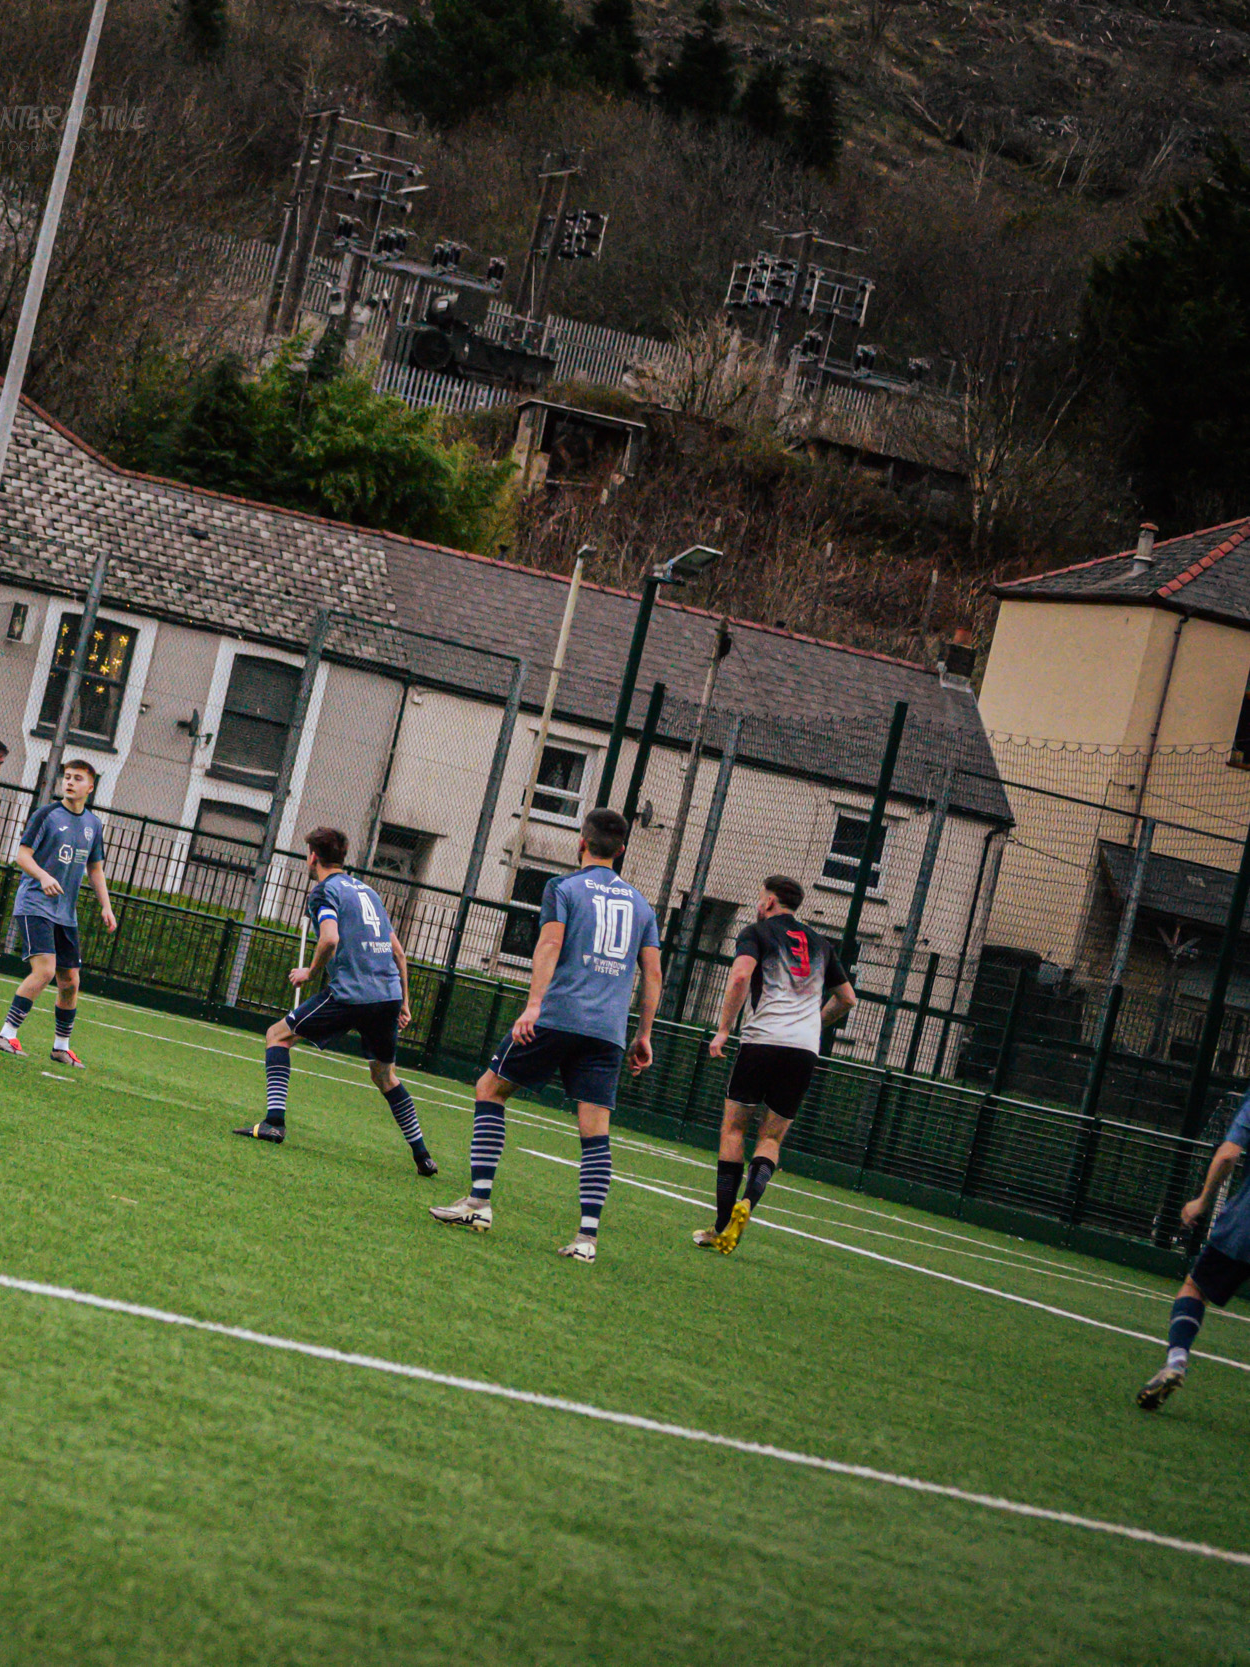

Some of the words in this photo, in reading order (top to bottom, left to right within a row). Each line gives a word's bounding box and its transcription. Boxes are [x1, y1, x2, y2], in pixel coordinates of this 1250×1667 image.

[584, 879, 634, 898] Everest
[357, 892, 381, 937] 4
[592, 895, 633, 959] 10
[786, 930, 811, 977] 3
